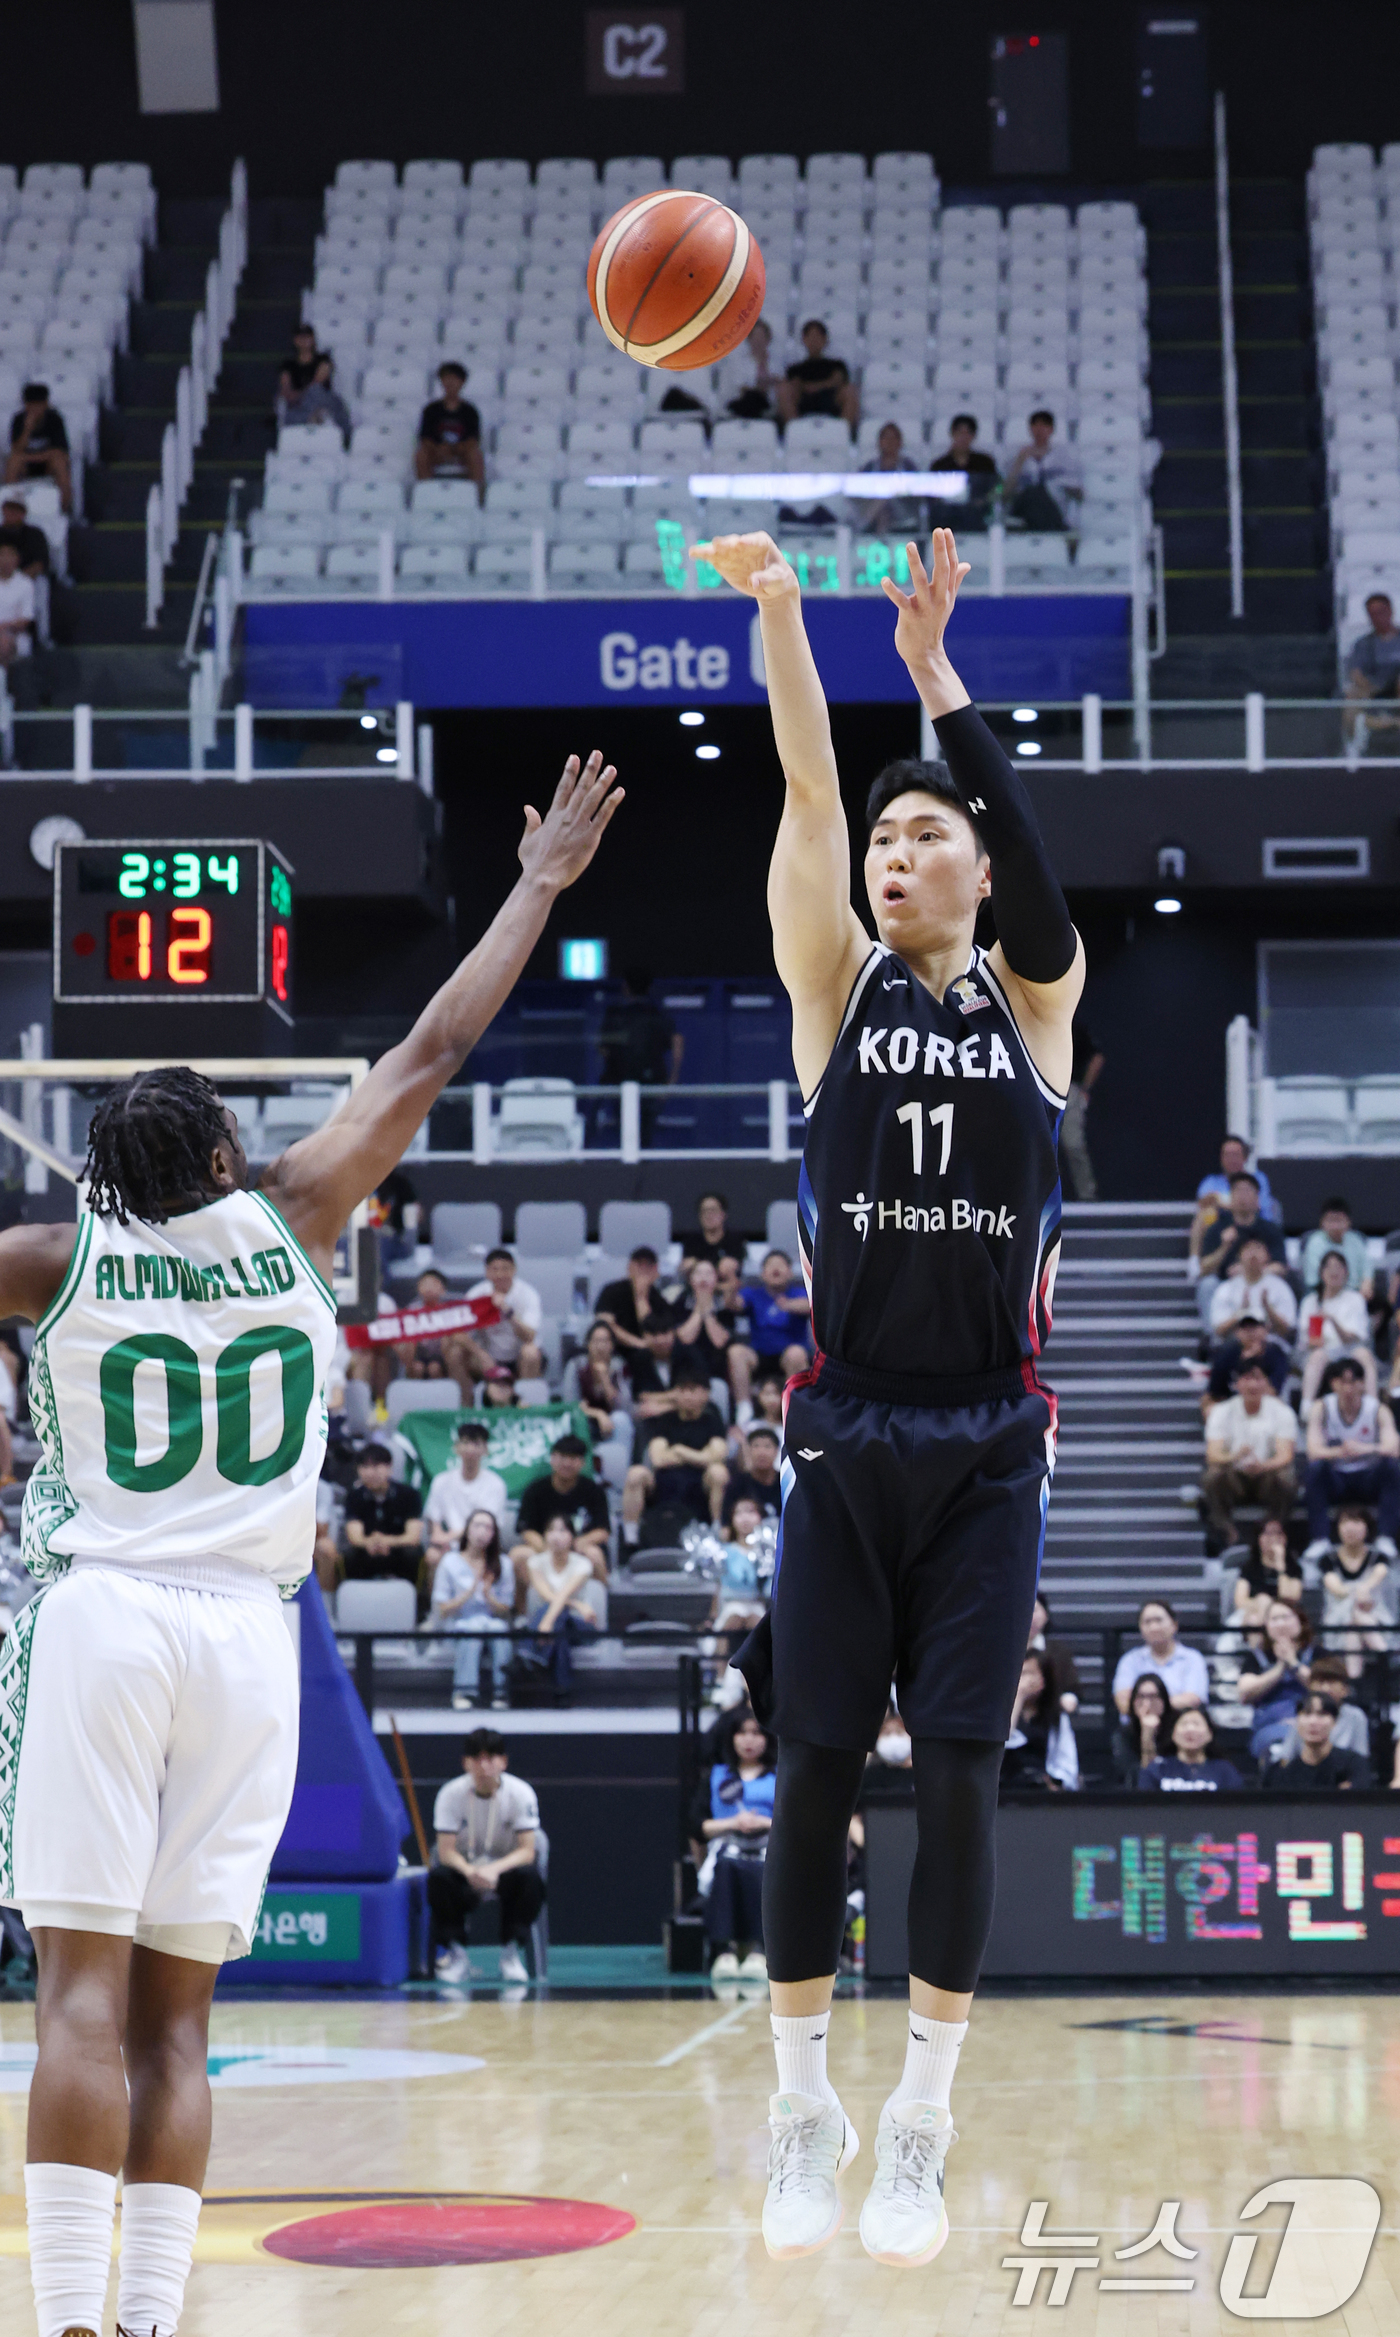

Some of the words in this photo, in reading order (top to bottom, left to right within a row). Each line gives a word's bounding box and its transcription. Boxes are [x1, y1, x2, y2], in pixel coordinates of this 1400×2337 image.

[603, 23, 667, 78] C2
[712, 284, 761, 349] molten
[600, 632, 730, 690] Gate
[118, 853, 239, 898] 2:34
[138, 908, 211, 983] 12
[858, 1026, 1016, 1079] KOREA
[896, 1101, 954, 1175] 11
[878, 1199, 946, 1232] Hana
[952, 1199, 1017, 1239] Bnk
[100, 1325, 315, 1493] 00
